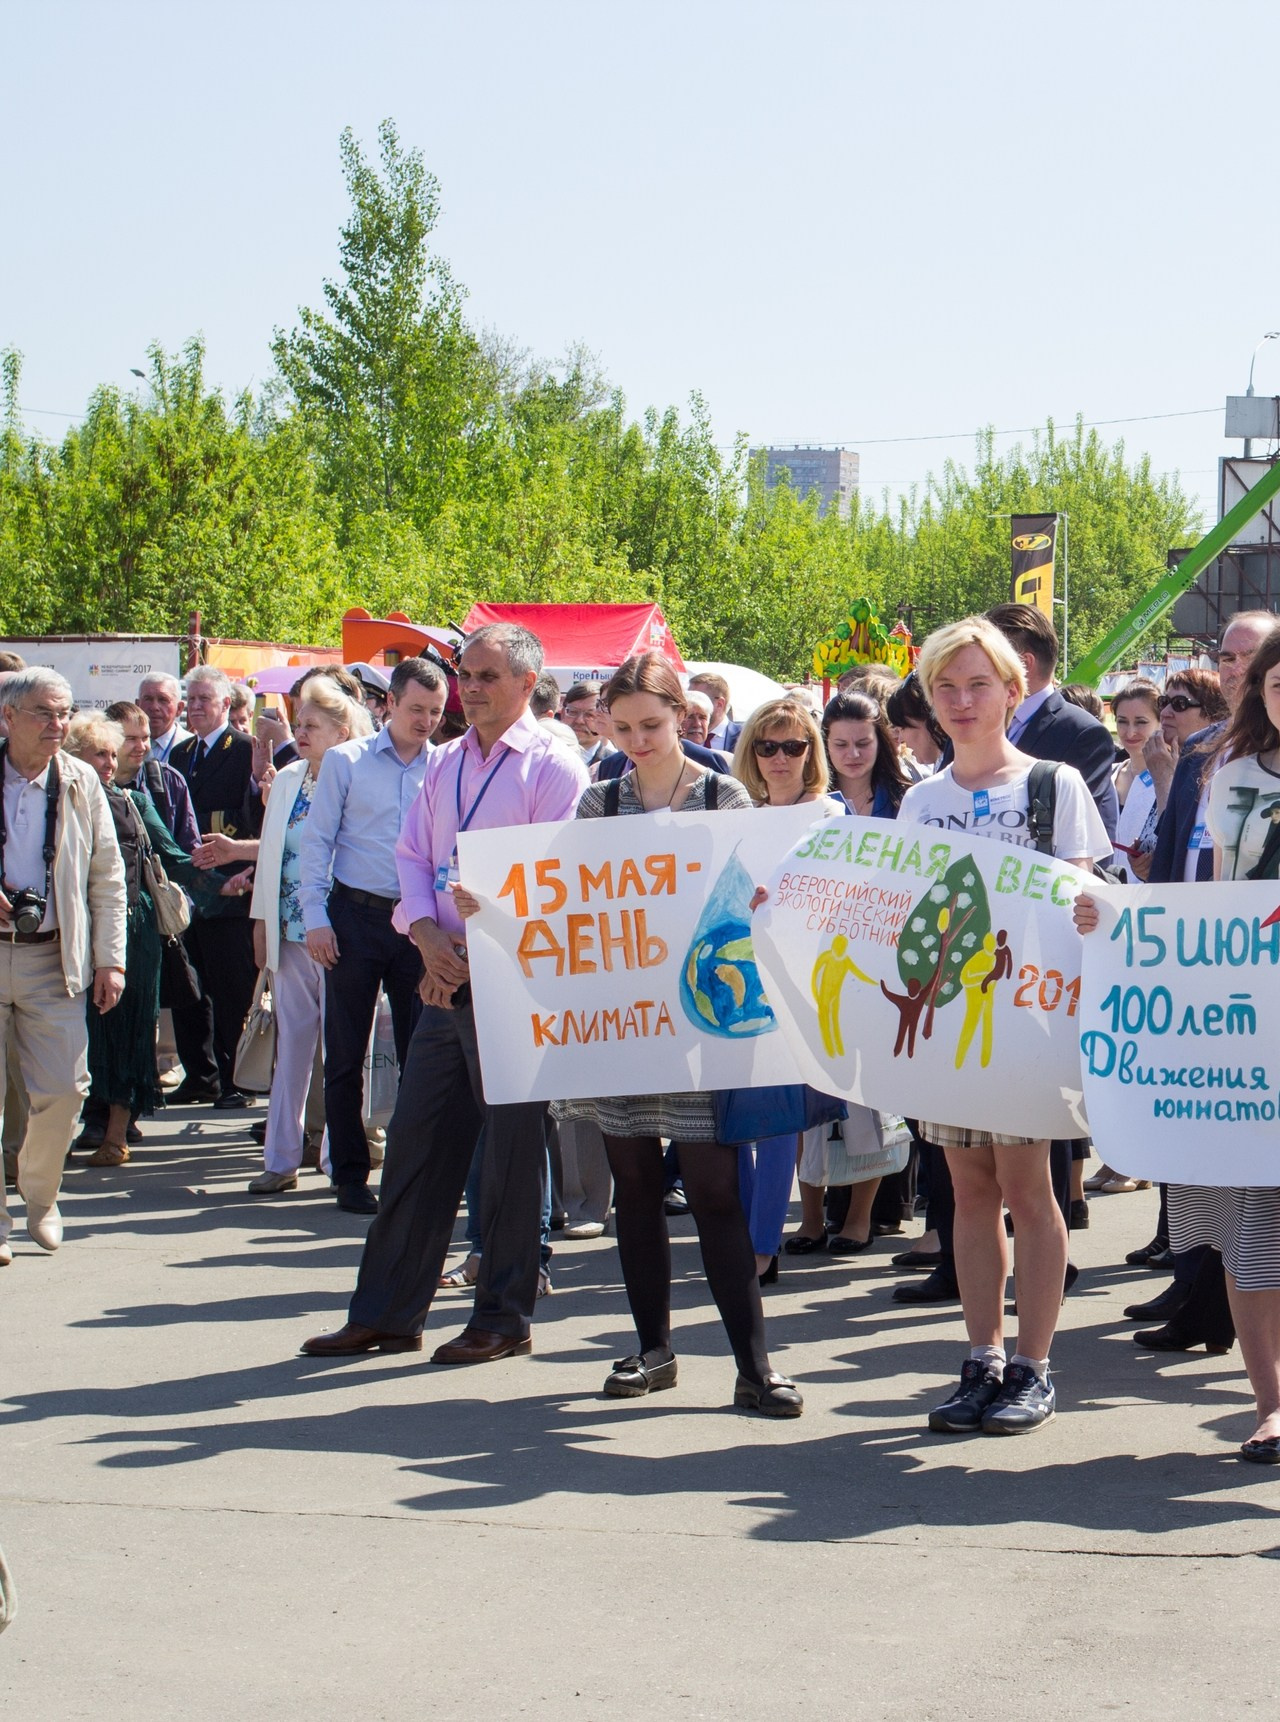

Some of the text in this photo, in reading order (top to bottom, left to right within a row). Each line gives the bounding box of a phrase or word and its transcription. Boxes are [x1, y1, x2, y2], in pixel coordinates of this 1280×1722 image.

[1143, 591, 1169, 618] MERLO
[133, 664, 151, 674] 2017
[795, 829, 951, 881] ЗЕЛЕНАЯ
[497, 858, 567, 917] 15
[774, 891, 908, 928] ЭКОЛОГИЧЕСКИЙ
[778, 872, 912, 910] ВСЕРОССИЙСКИЙ
[517, 908, 669, 979] ДЕНЬ
[806, 913, 900, 949] СУББОТНИК
[1110, 906, 1167, 968] 15
[1013, 963, 1081, 1017] 201
[1100, 985, 1173, 1035] 100
[531, 1001, 676, 1048] КЛИМАТА
[1080, 1030, 1270, 1090] Движения
